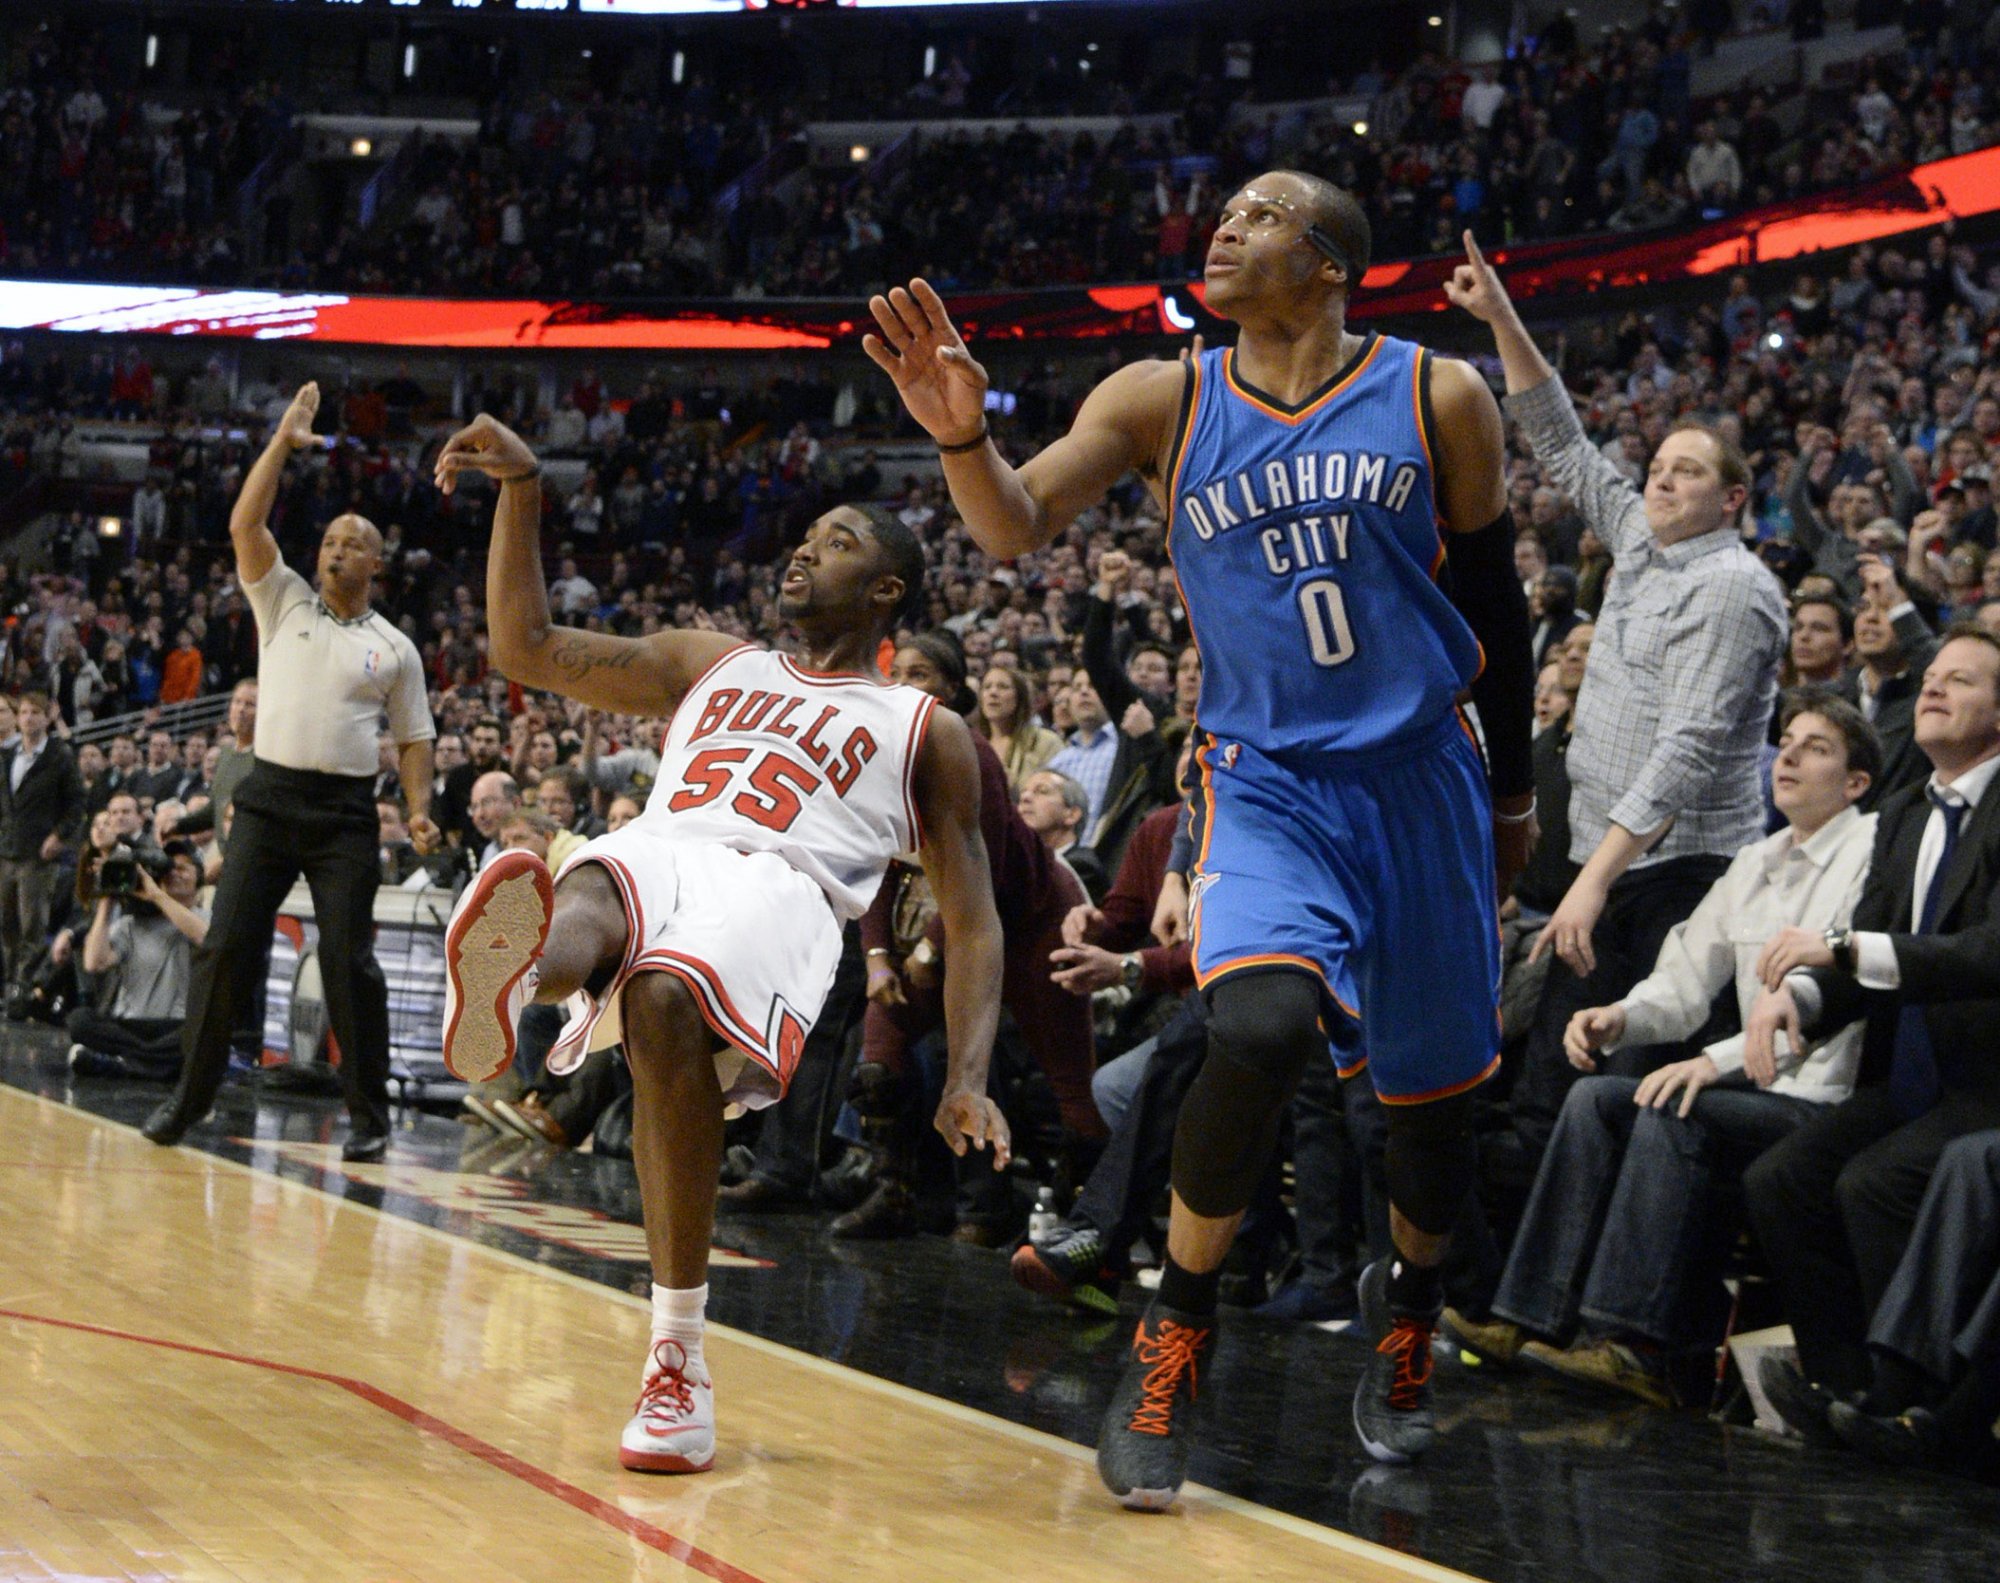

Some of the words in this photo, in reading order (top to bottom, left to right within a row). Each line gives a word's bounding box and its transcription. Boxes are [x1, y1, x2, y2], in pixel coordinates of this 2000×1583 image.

[1183, 451, 1418, 542] OKLAHOMA
[1259, 512, 1350, 576] CITY
[1298, 578, 1356, 668] 0
[685, 687, 878, 799] BULLS
[667, 747, 822, 834] 55
